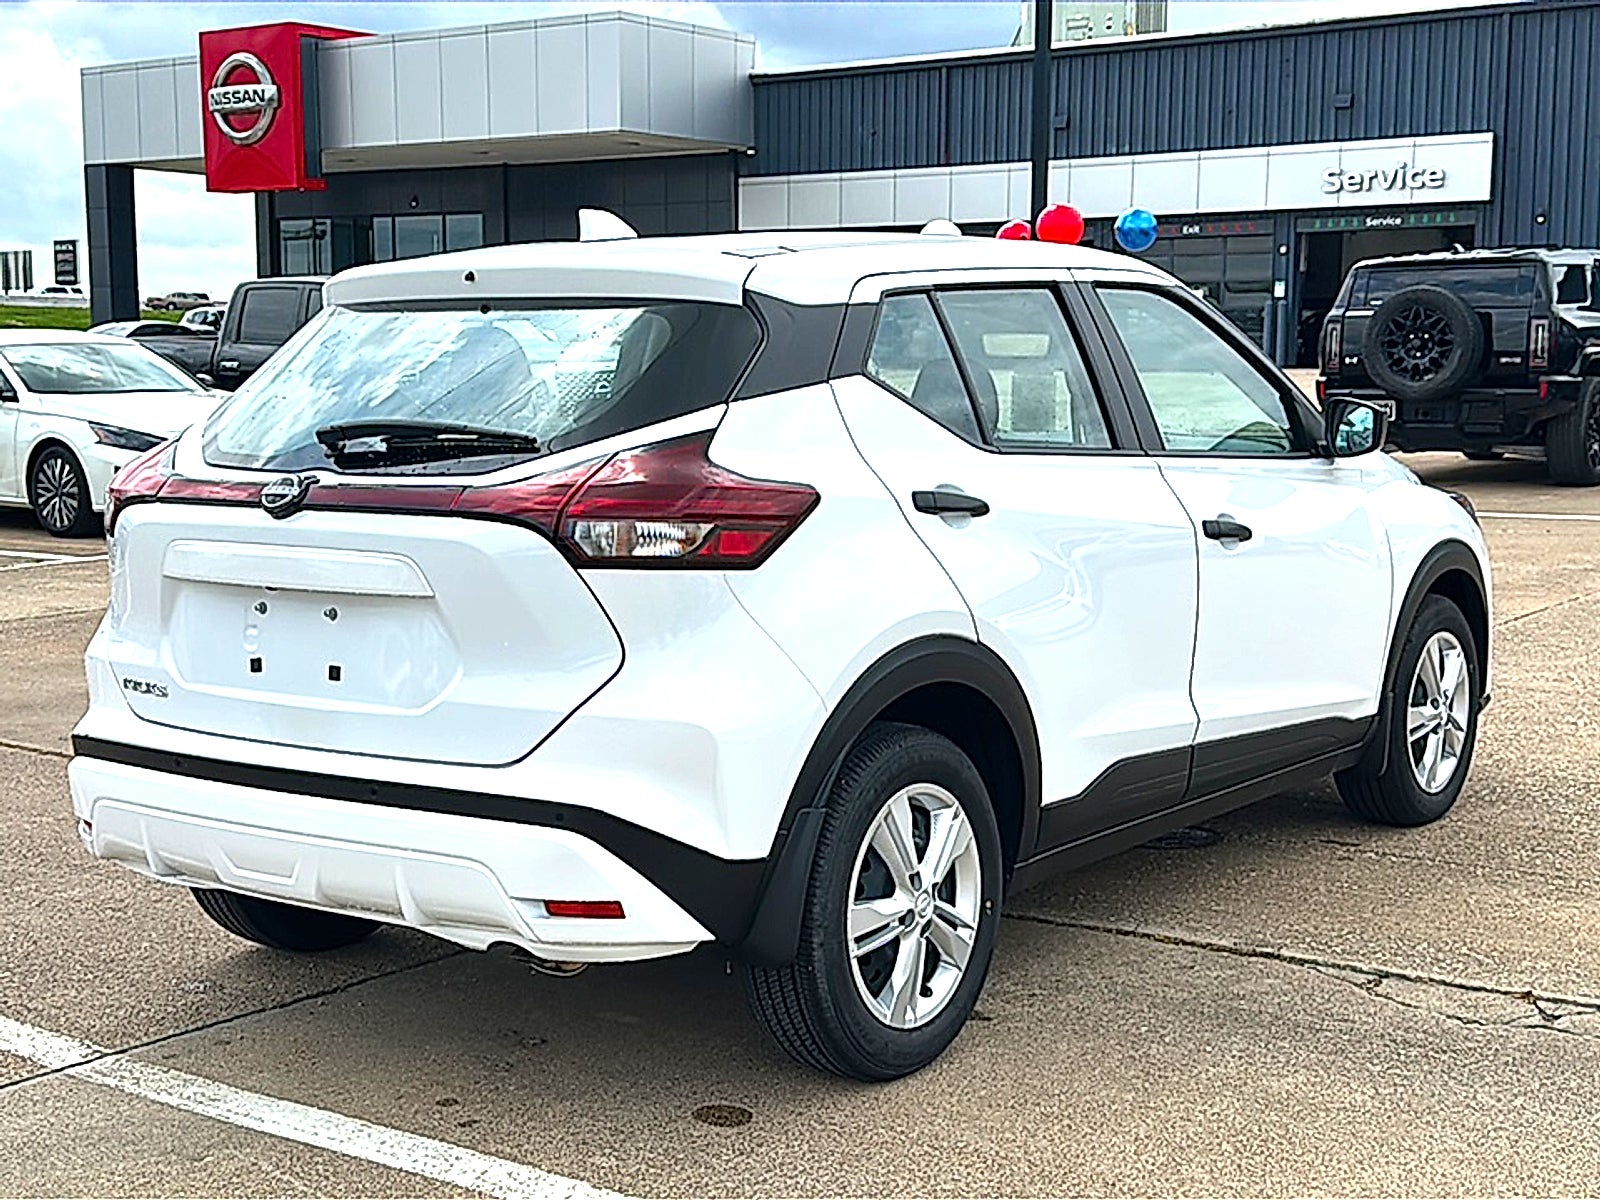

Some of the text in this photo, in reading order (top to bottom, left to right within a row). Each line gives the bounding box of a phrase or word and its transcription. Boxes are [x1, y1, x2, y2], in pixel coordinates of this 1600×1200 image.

[210, 88, 266, 106] NISSAN
[1321, 160, 1446, 194] Service
[1181, 223, 1201, 235] Exit
[1364, 215, 1403, 228] Service
